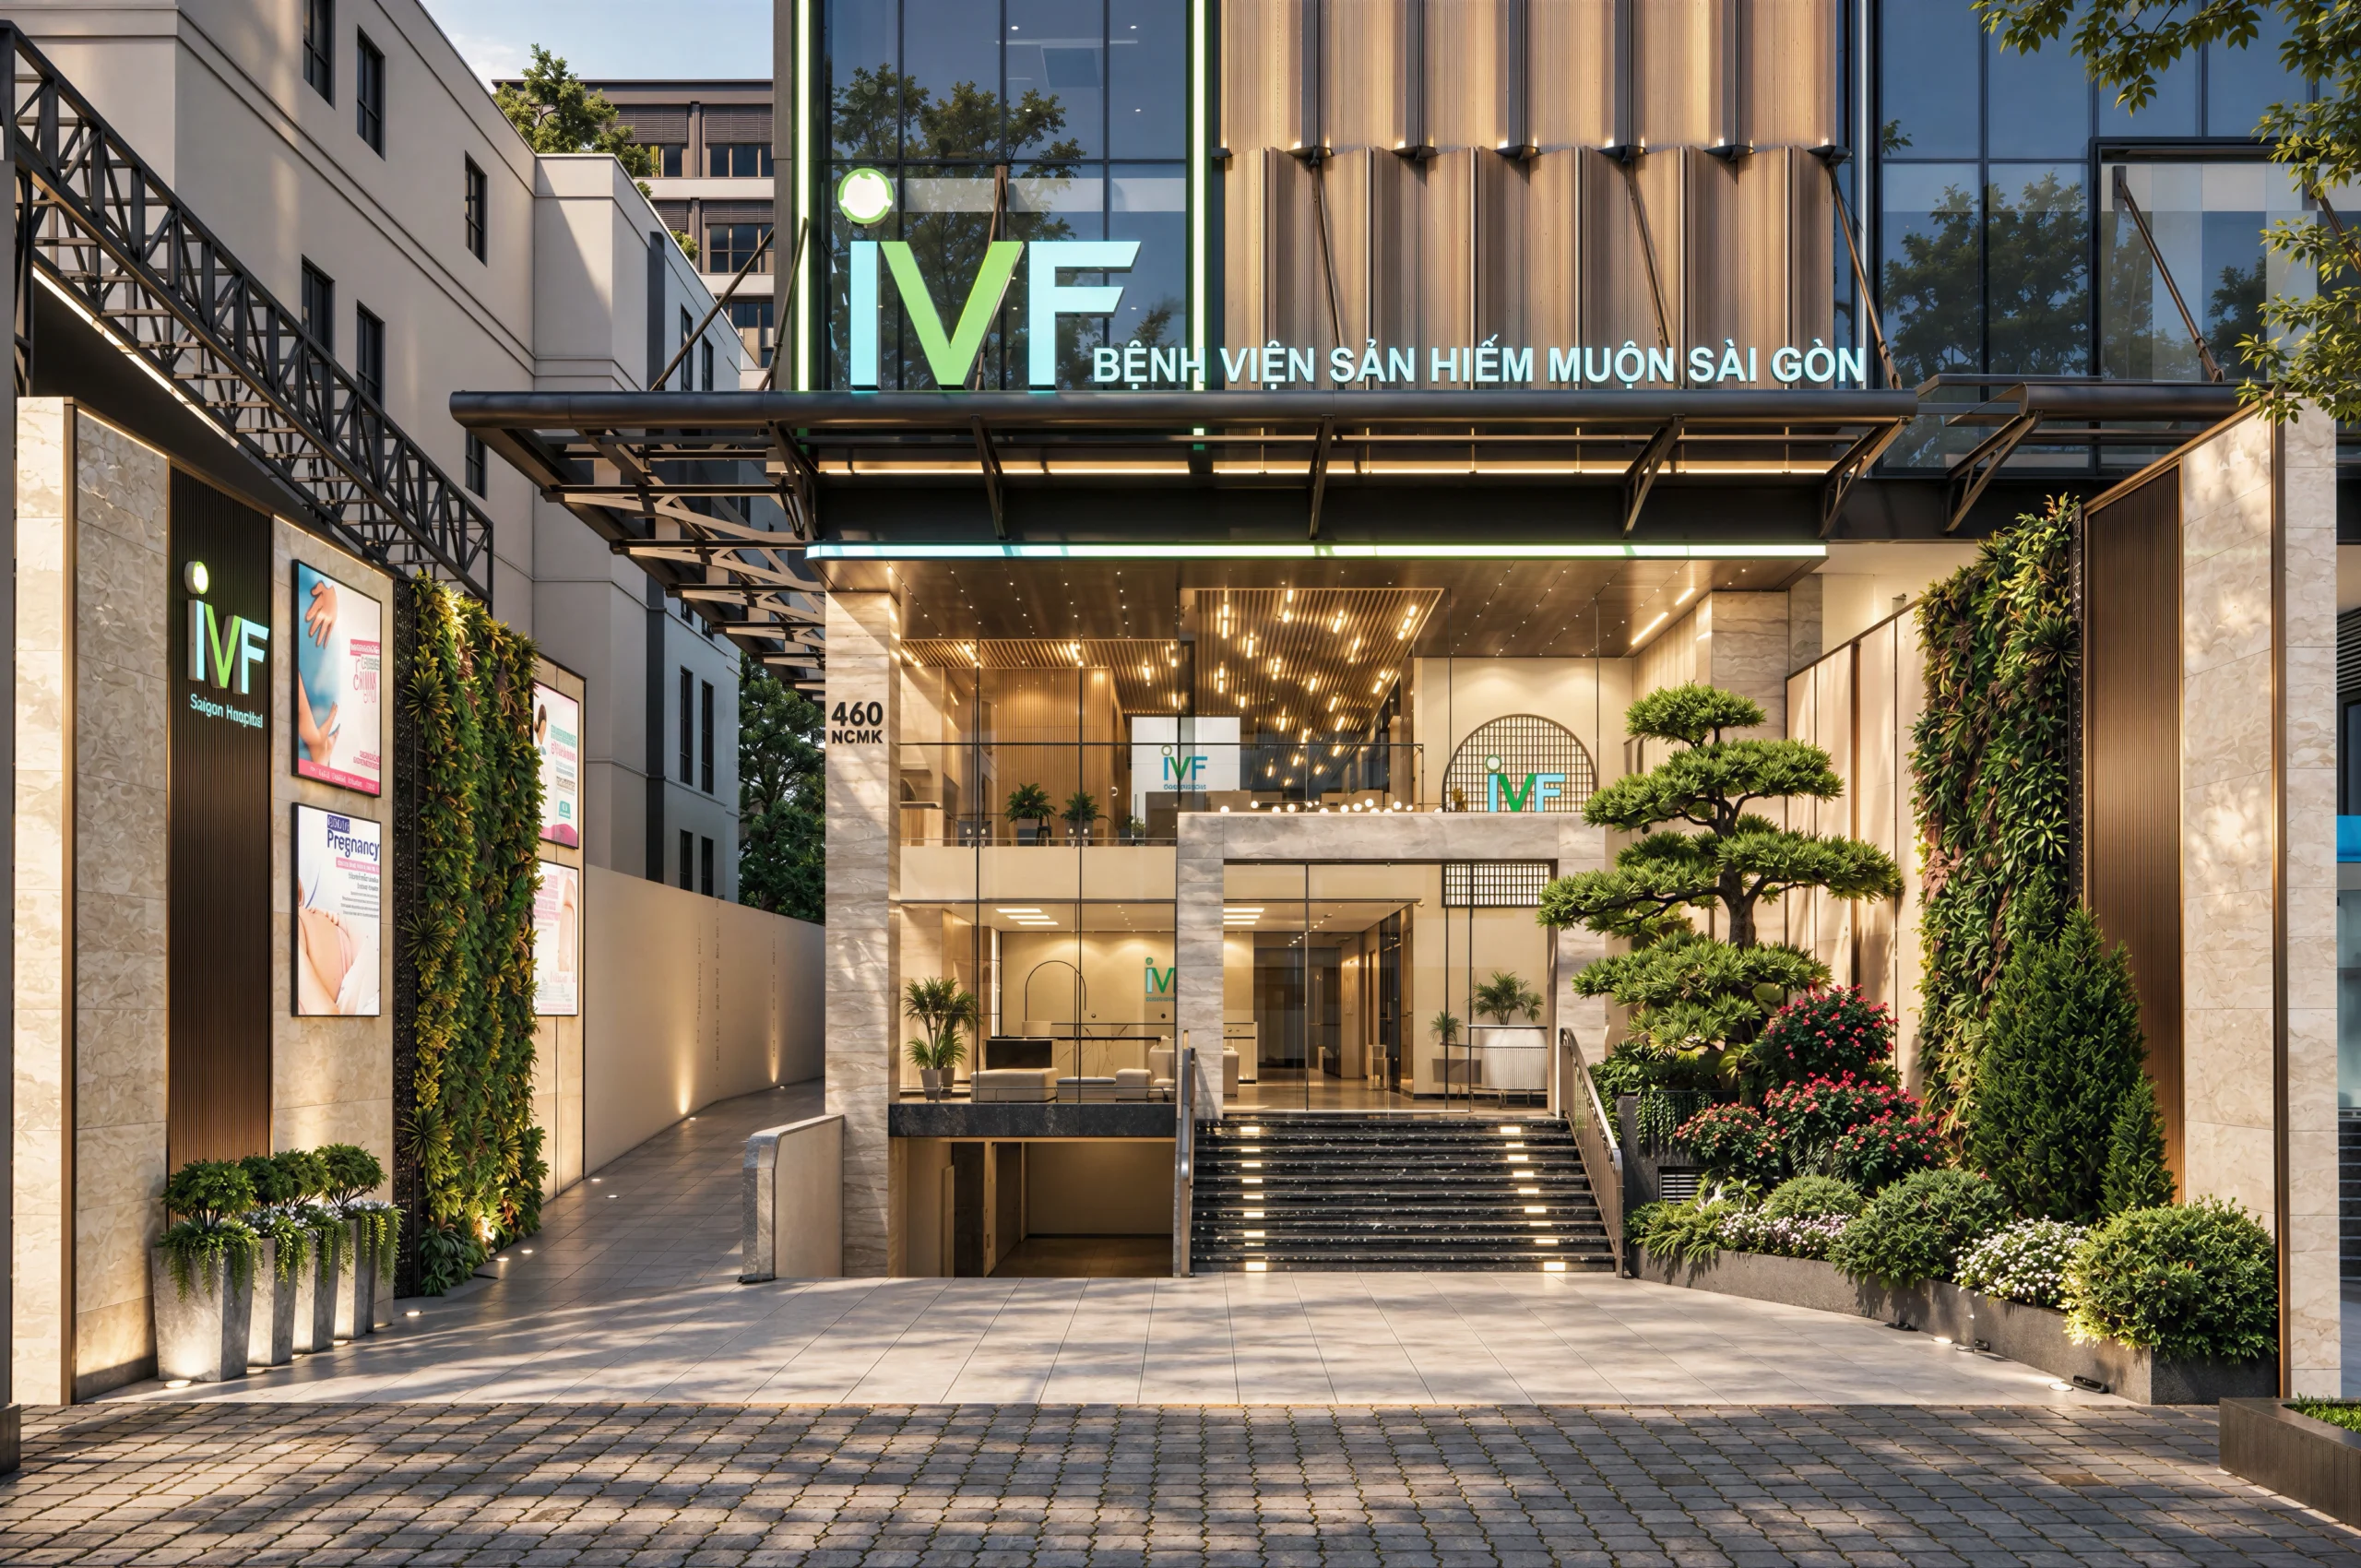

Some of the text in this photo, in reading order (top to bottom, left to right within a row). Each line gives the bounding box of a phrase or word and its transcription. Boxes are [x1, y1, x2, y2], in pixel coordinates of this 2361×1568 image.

[1093, 334, 1865, 390] BỆNH VIỆN SẢN HIẾM MUỘN SÀI GÒN
[831, 701, 884, 727] 460
[831, 730, 884, 744] NCMK
[326, 828, 380, 861] Pregnancy
